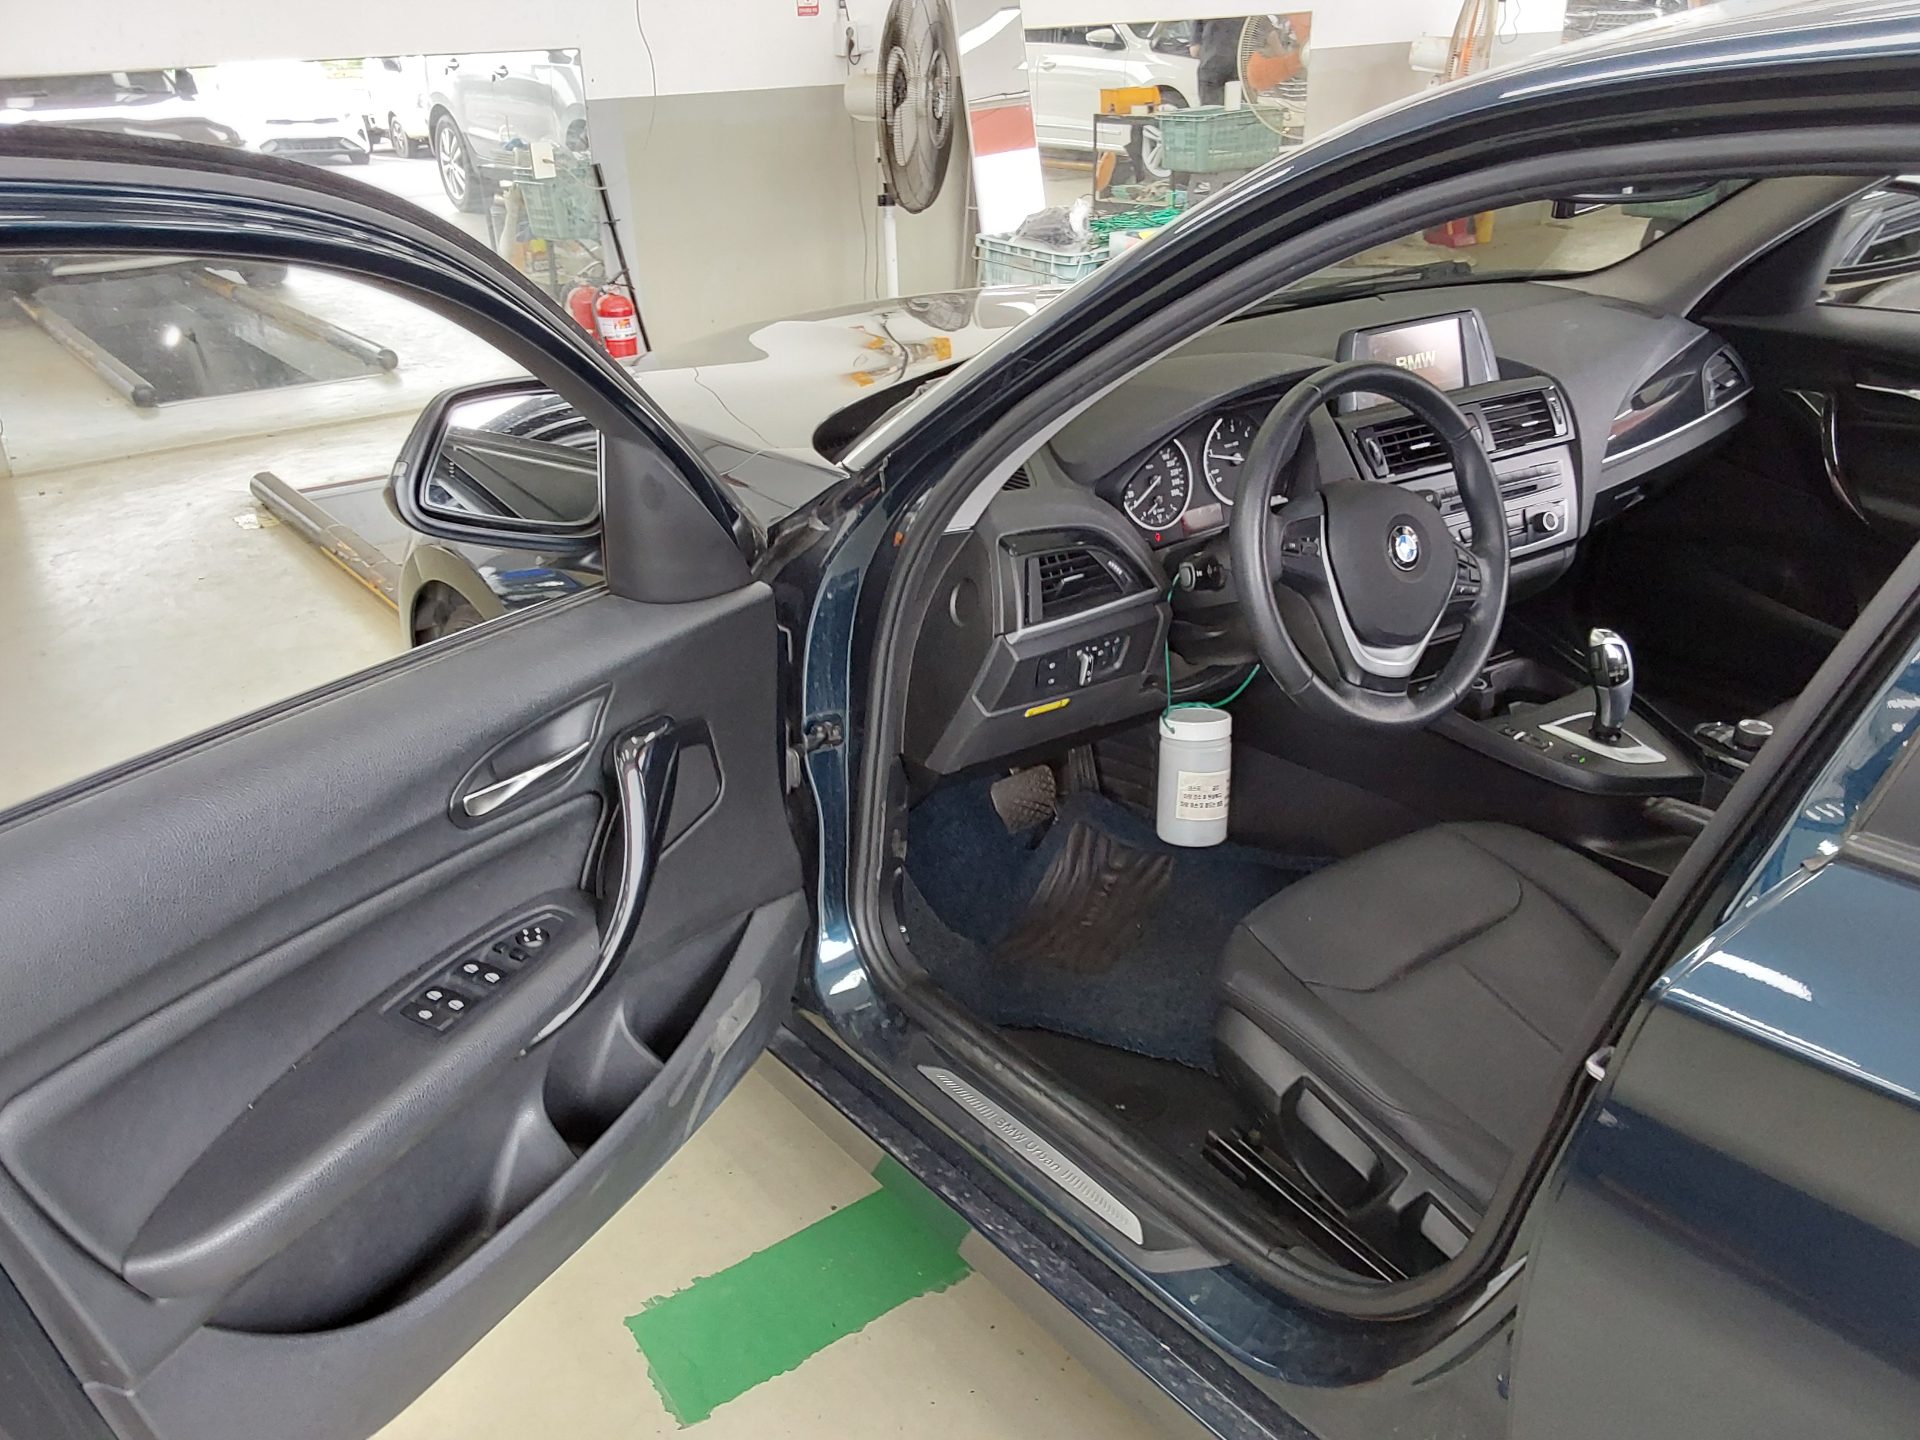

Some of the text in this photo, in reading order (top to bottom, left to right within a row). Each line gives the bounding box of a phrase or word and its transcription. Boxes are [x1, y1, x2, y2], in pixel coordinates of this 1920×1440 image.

[1395, 350, 1437, 370] BMW
[996, 1118, 1061, 1172] BMW Urban
